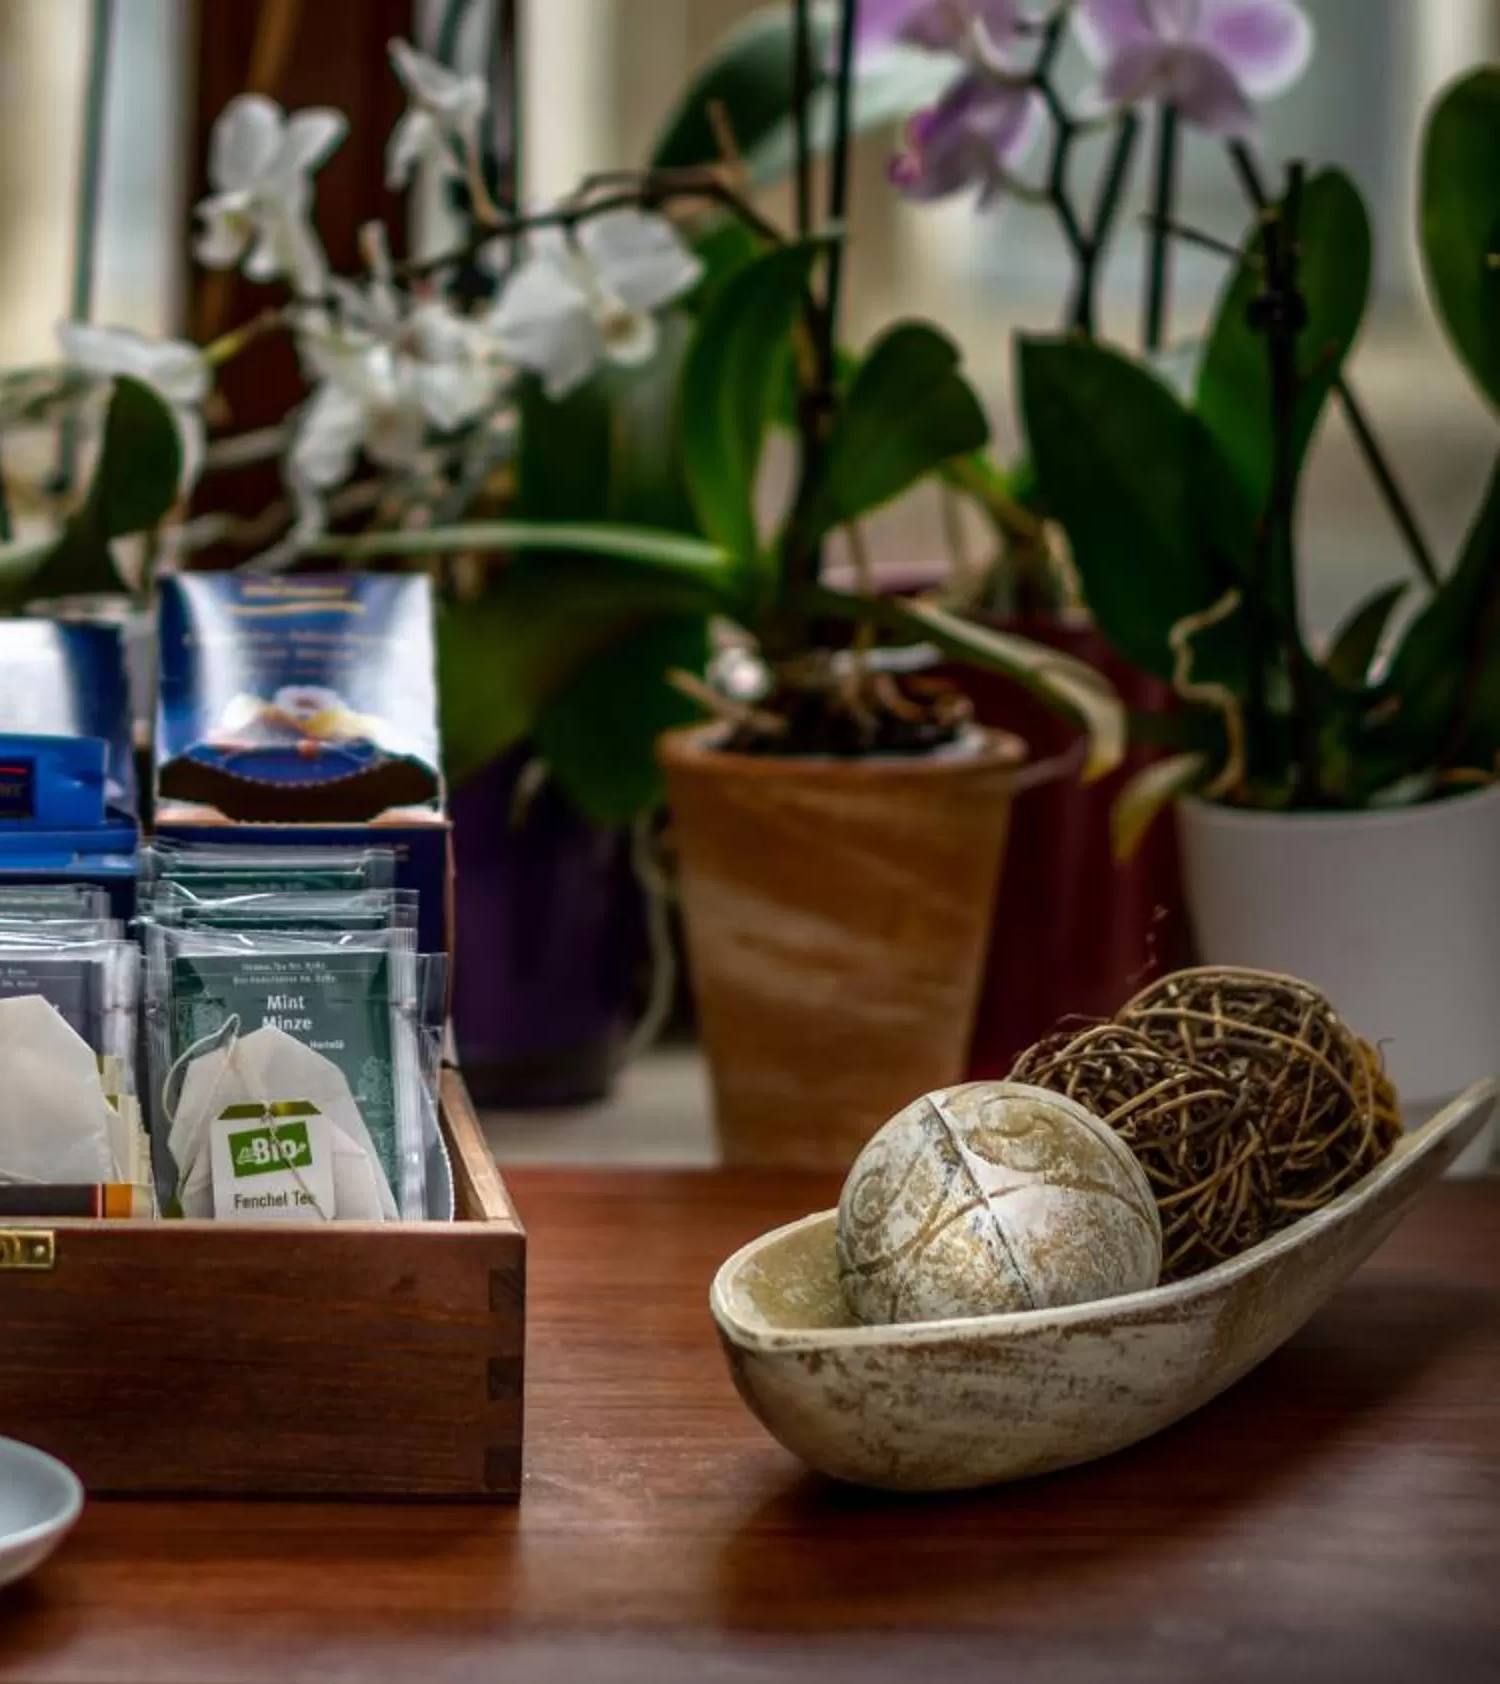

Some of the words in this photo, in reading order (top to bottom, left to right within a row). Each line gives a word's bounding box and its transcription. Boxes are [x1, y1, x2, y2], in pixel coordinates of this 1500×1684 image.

[267, 994, 305, 1011] Mint
[262, 1015, 313, 1031] Minze
[234, 1191, 288, 1209] Fenchel
